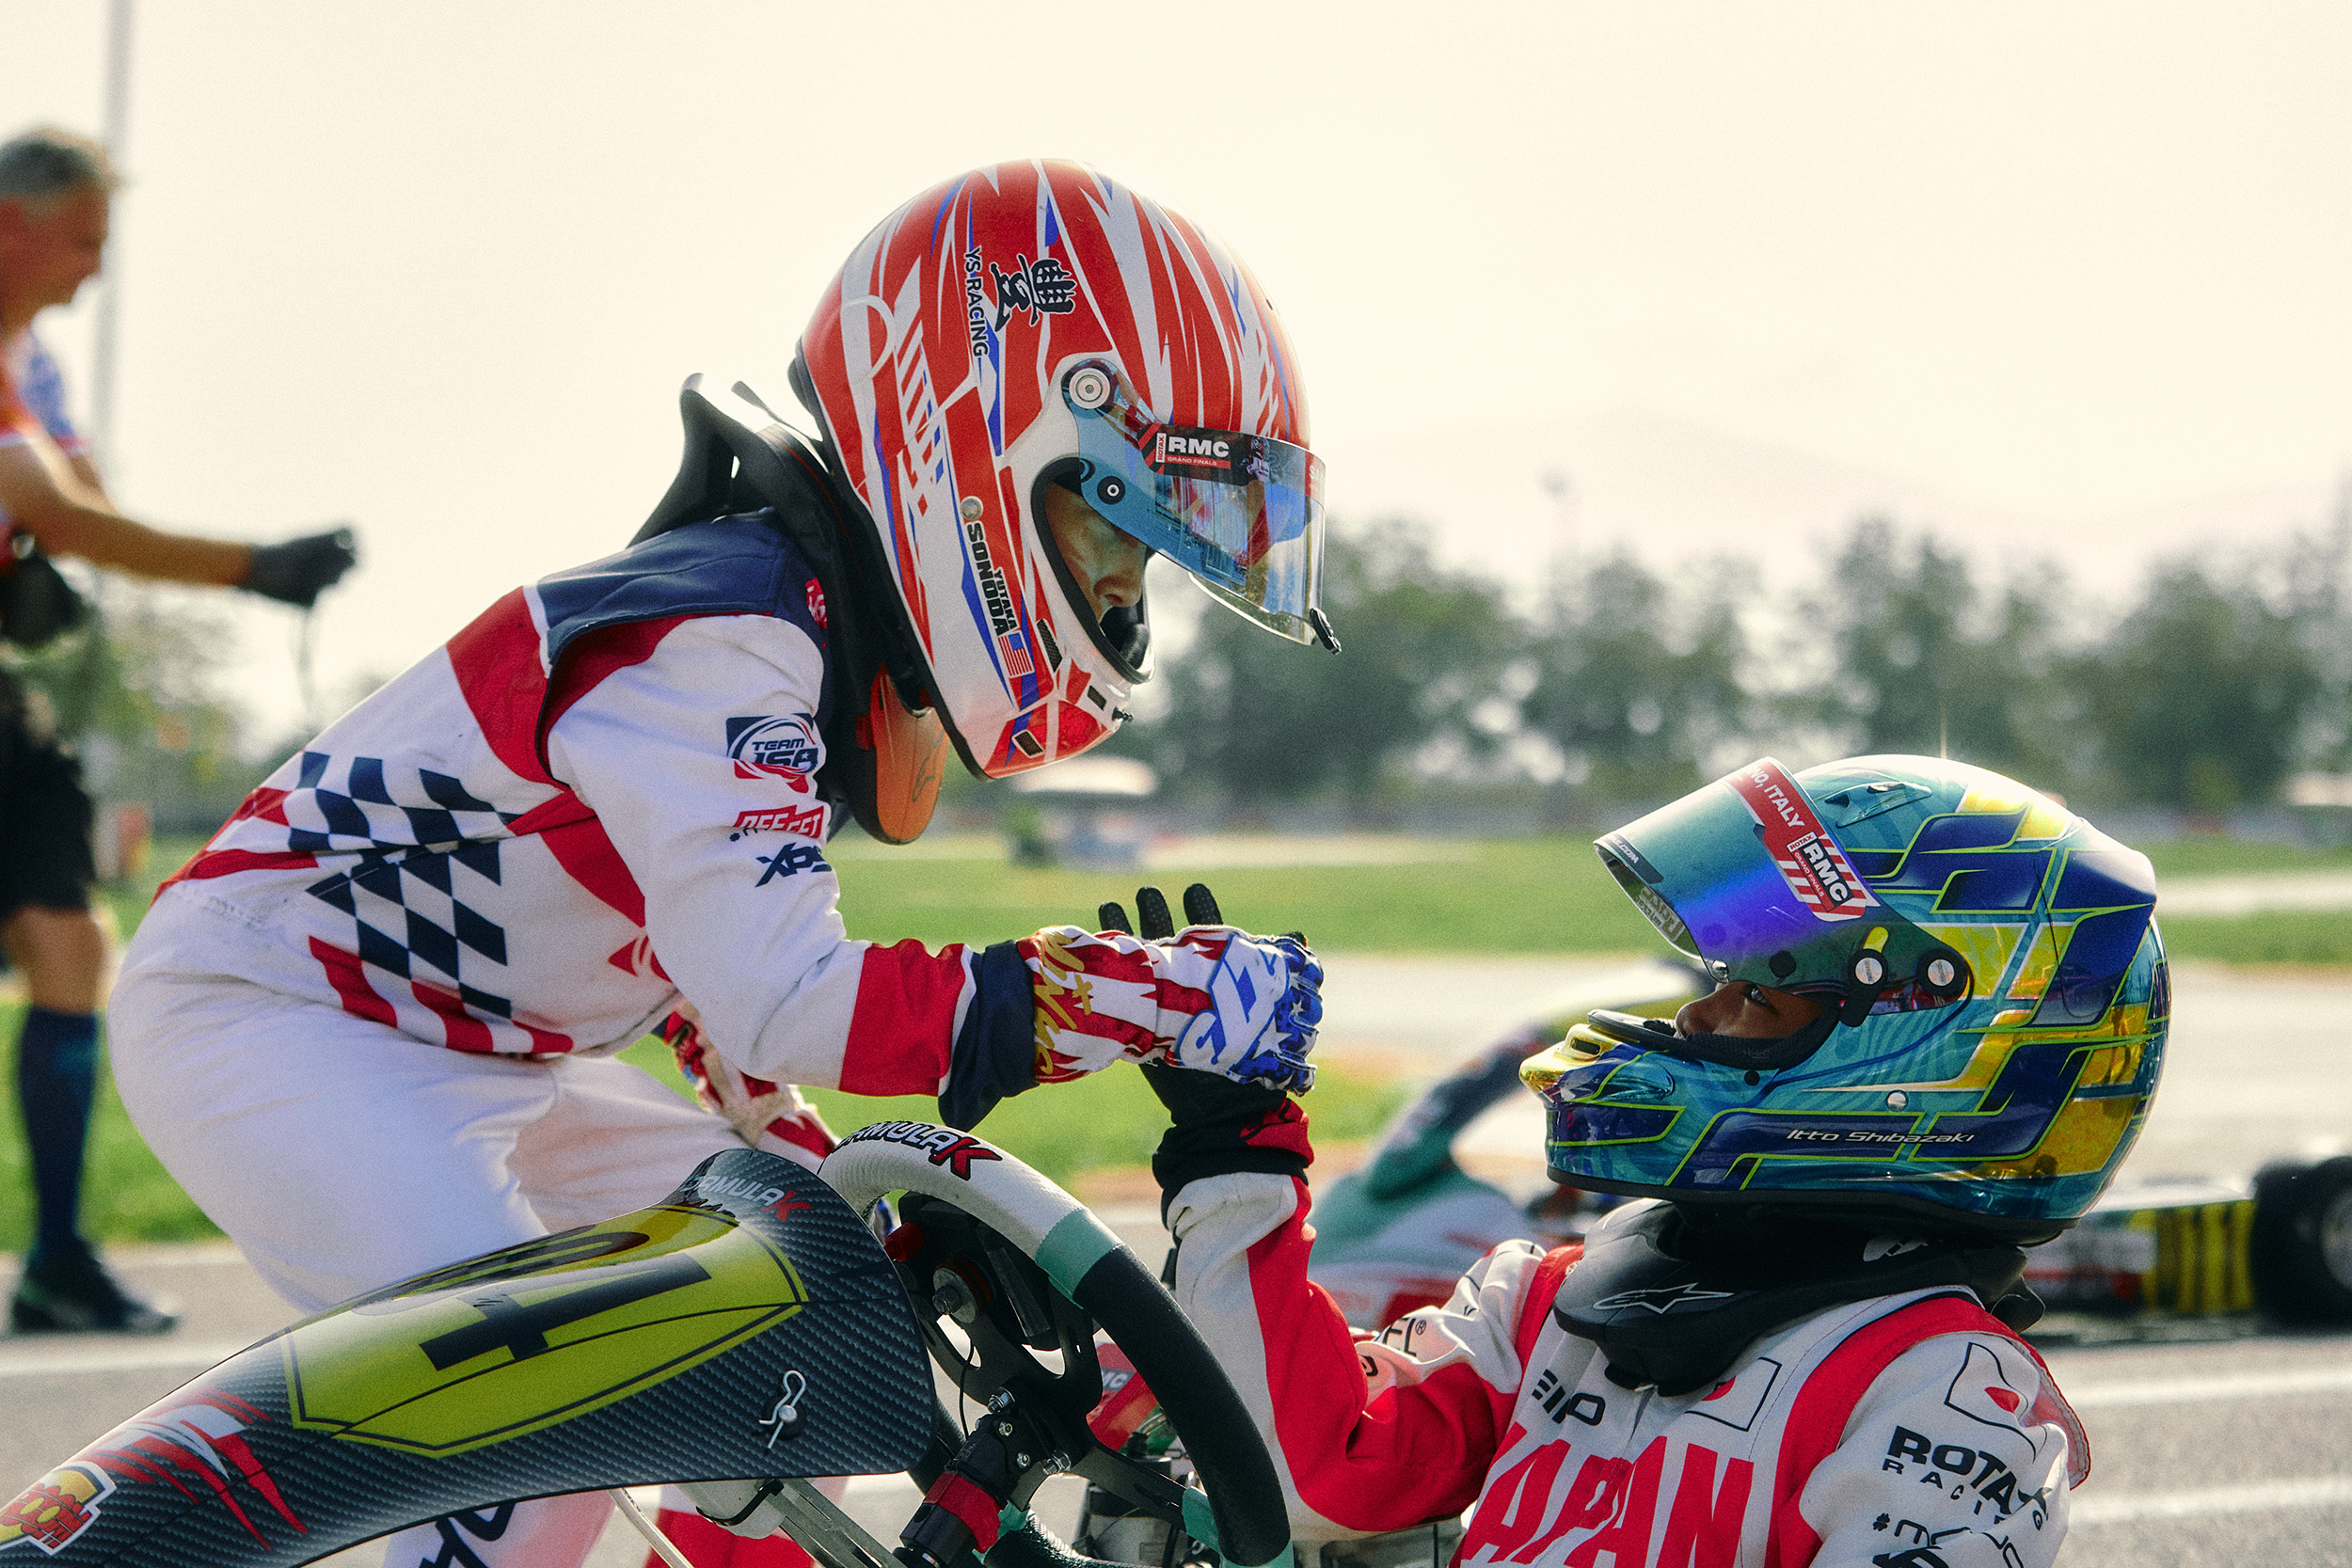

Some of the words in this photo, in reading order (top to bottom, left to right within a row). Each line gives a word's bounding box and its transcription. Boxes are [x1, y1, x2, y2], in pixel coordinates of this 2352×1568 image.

[965, 246, 981, 273] YS
[966, 277, 989, 357] RACING
[1167, 456, 1192, 465] GRAND
[1168, 436, 1230, 458] RMC
[966, 522, 1009, 637] SONODA
[994, 568, 1018, 631] YUTAKA
[752, 737, 805, 751] TEAM
[1764, 784, 1804, 828] ITALY
[1789, 834, 1814, 850] ROTAX
[1794, 852, 1810, 875] GRAND
[1807, 874, 1825, 898] FINALS
[1804, 842, 1849, 902] RMC
[1787, 1129, 1839, 1141] Itto
[1845, 1131, 1975, 1143] Shibazaki
